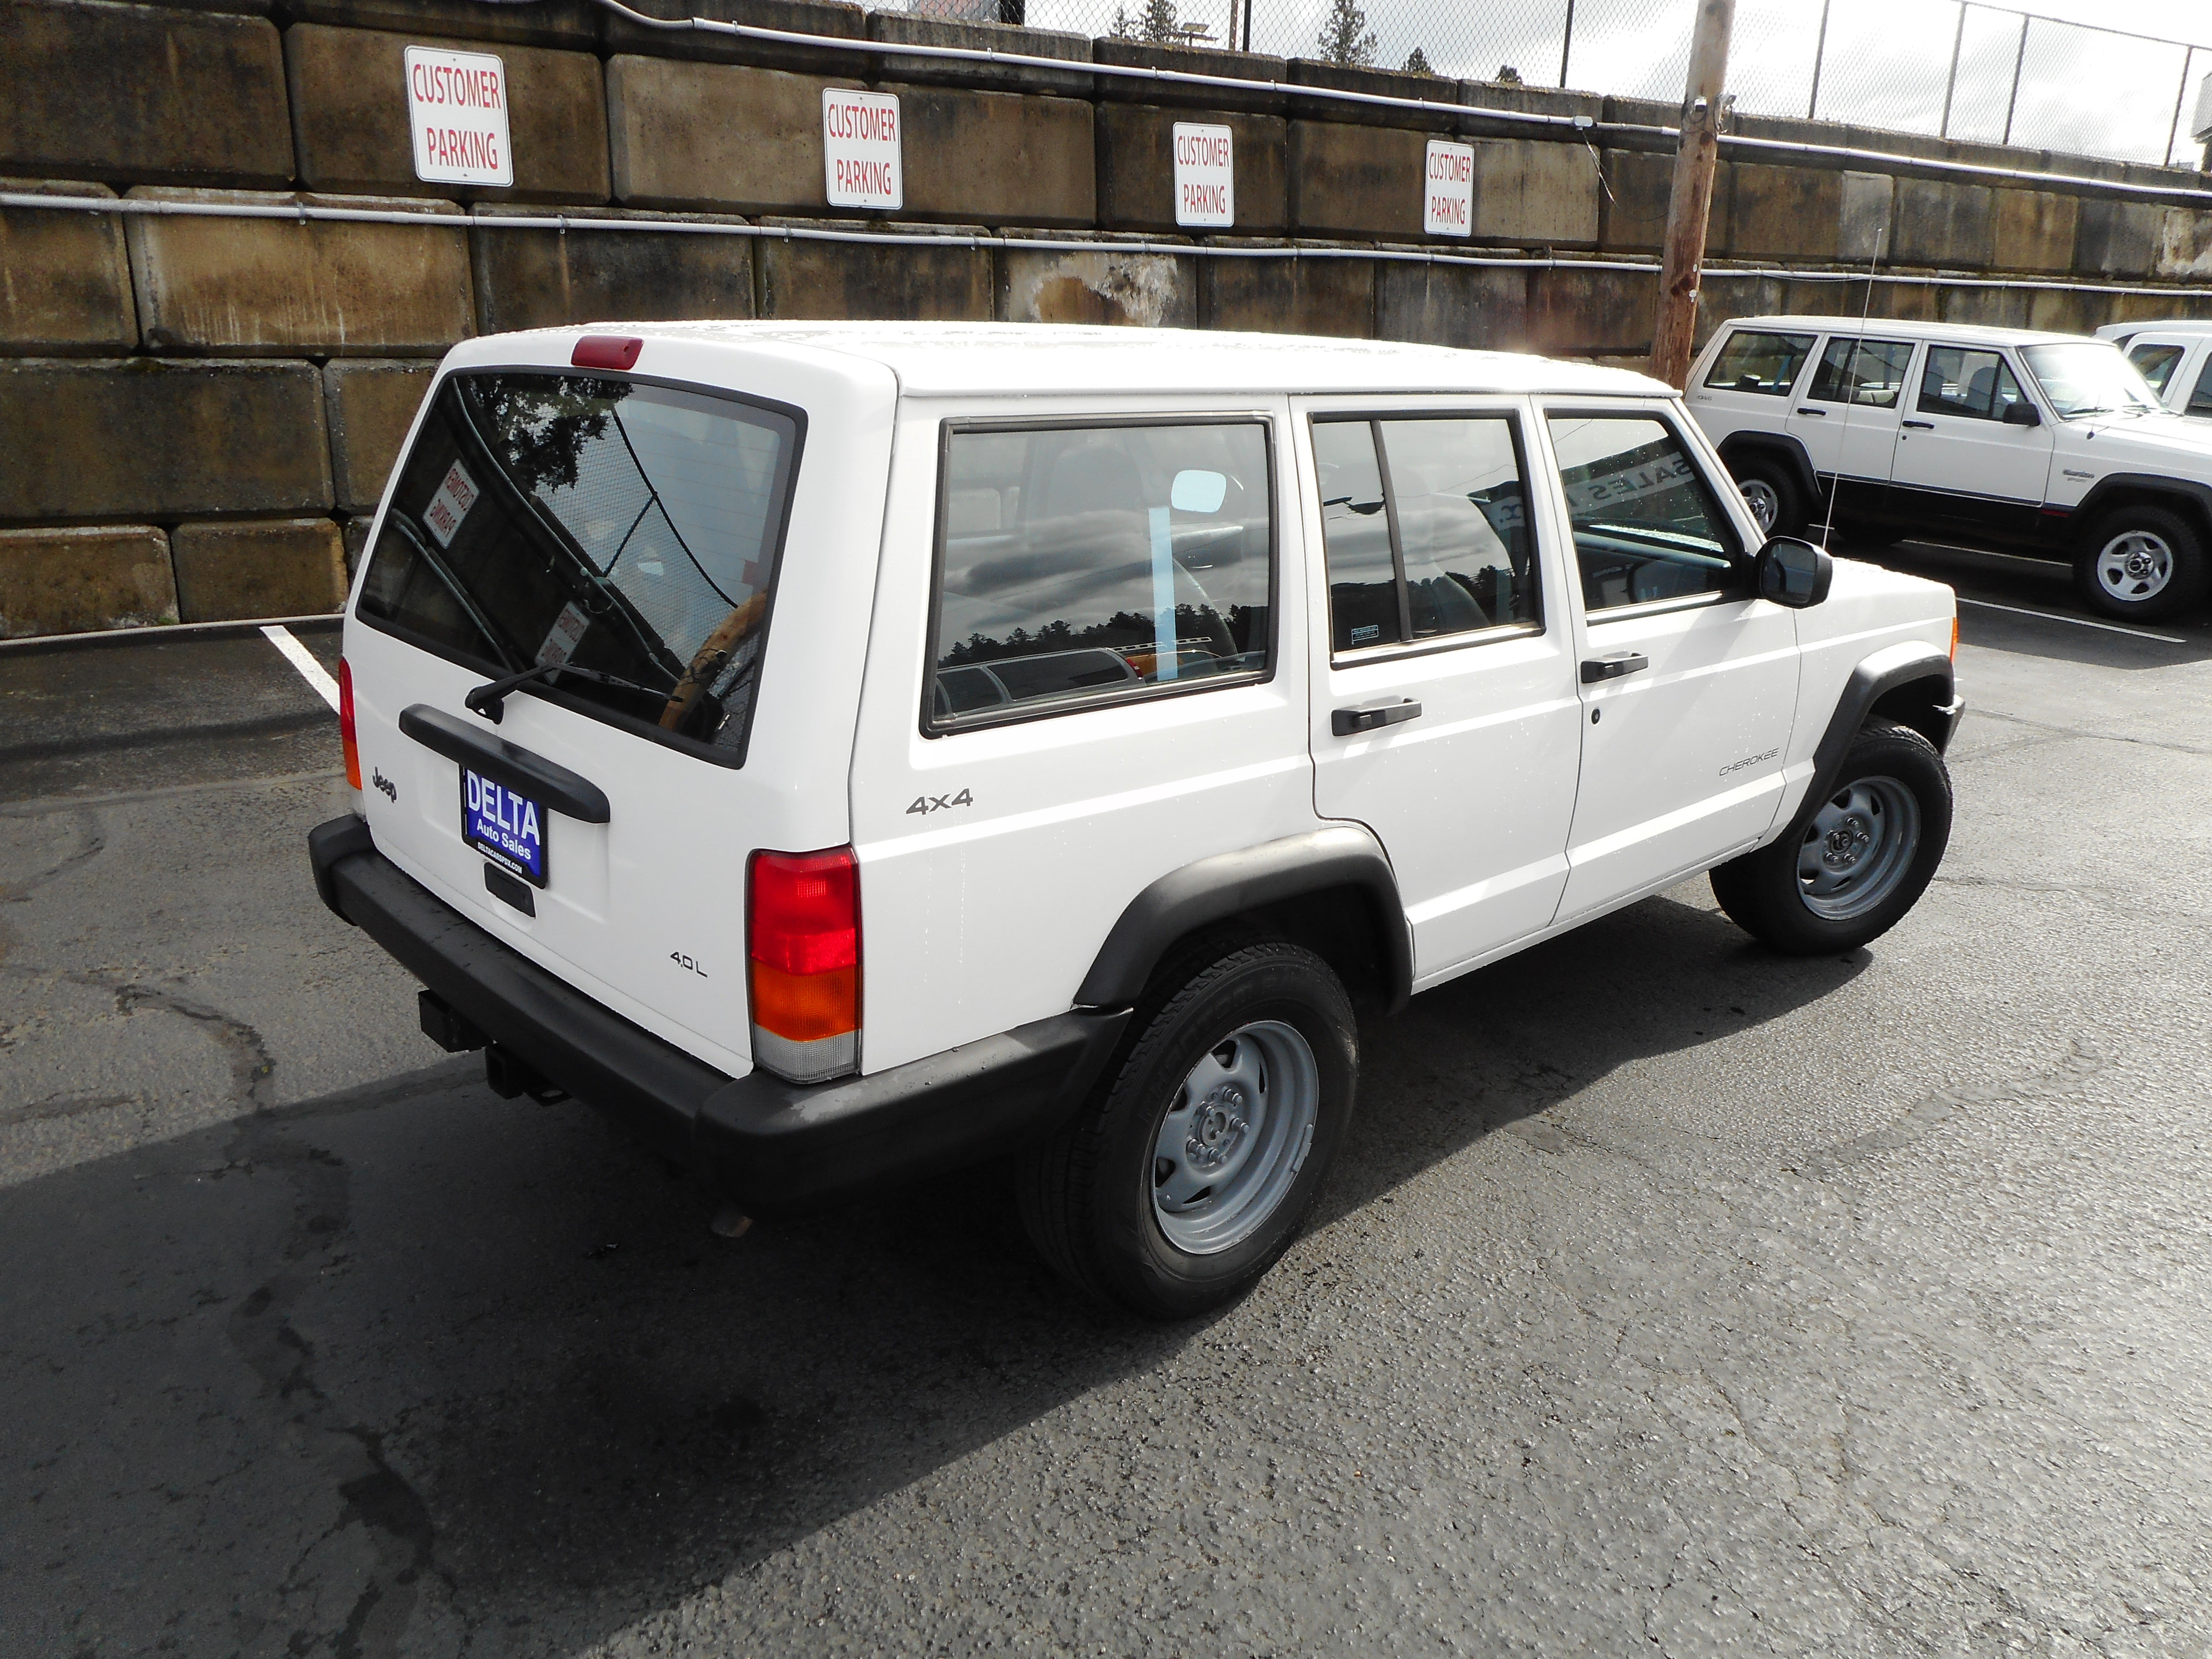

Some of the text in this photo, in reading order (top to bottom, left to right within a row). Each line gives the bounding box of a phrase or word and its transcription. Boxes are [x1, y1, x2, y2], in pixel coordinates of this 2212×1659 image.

[413, 64, 501, 109] CUSTOMER
[828, 103, 896, 142] CUSTOMER
[426, 127, 498, 170] PARKING
[1177, 135, 1230, 167] CUSTOMER
[837, 159, 891, 195] PARKING
[1429, 152, 1471, 183] CUSTOMER
[1183, 183, 1226, 214] PARKING
[1431, 195, 1465, 225] PARKING
[1719, 747, 1779, 776] CHEROKEE
[372, 766, 397, 804] Jeep
[467, 769, 540, 846] DELTA
[477, 818, 531, 860] Auto Sales
[477, 841, 523, 874] DELTACARSPDX.COM
